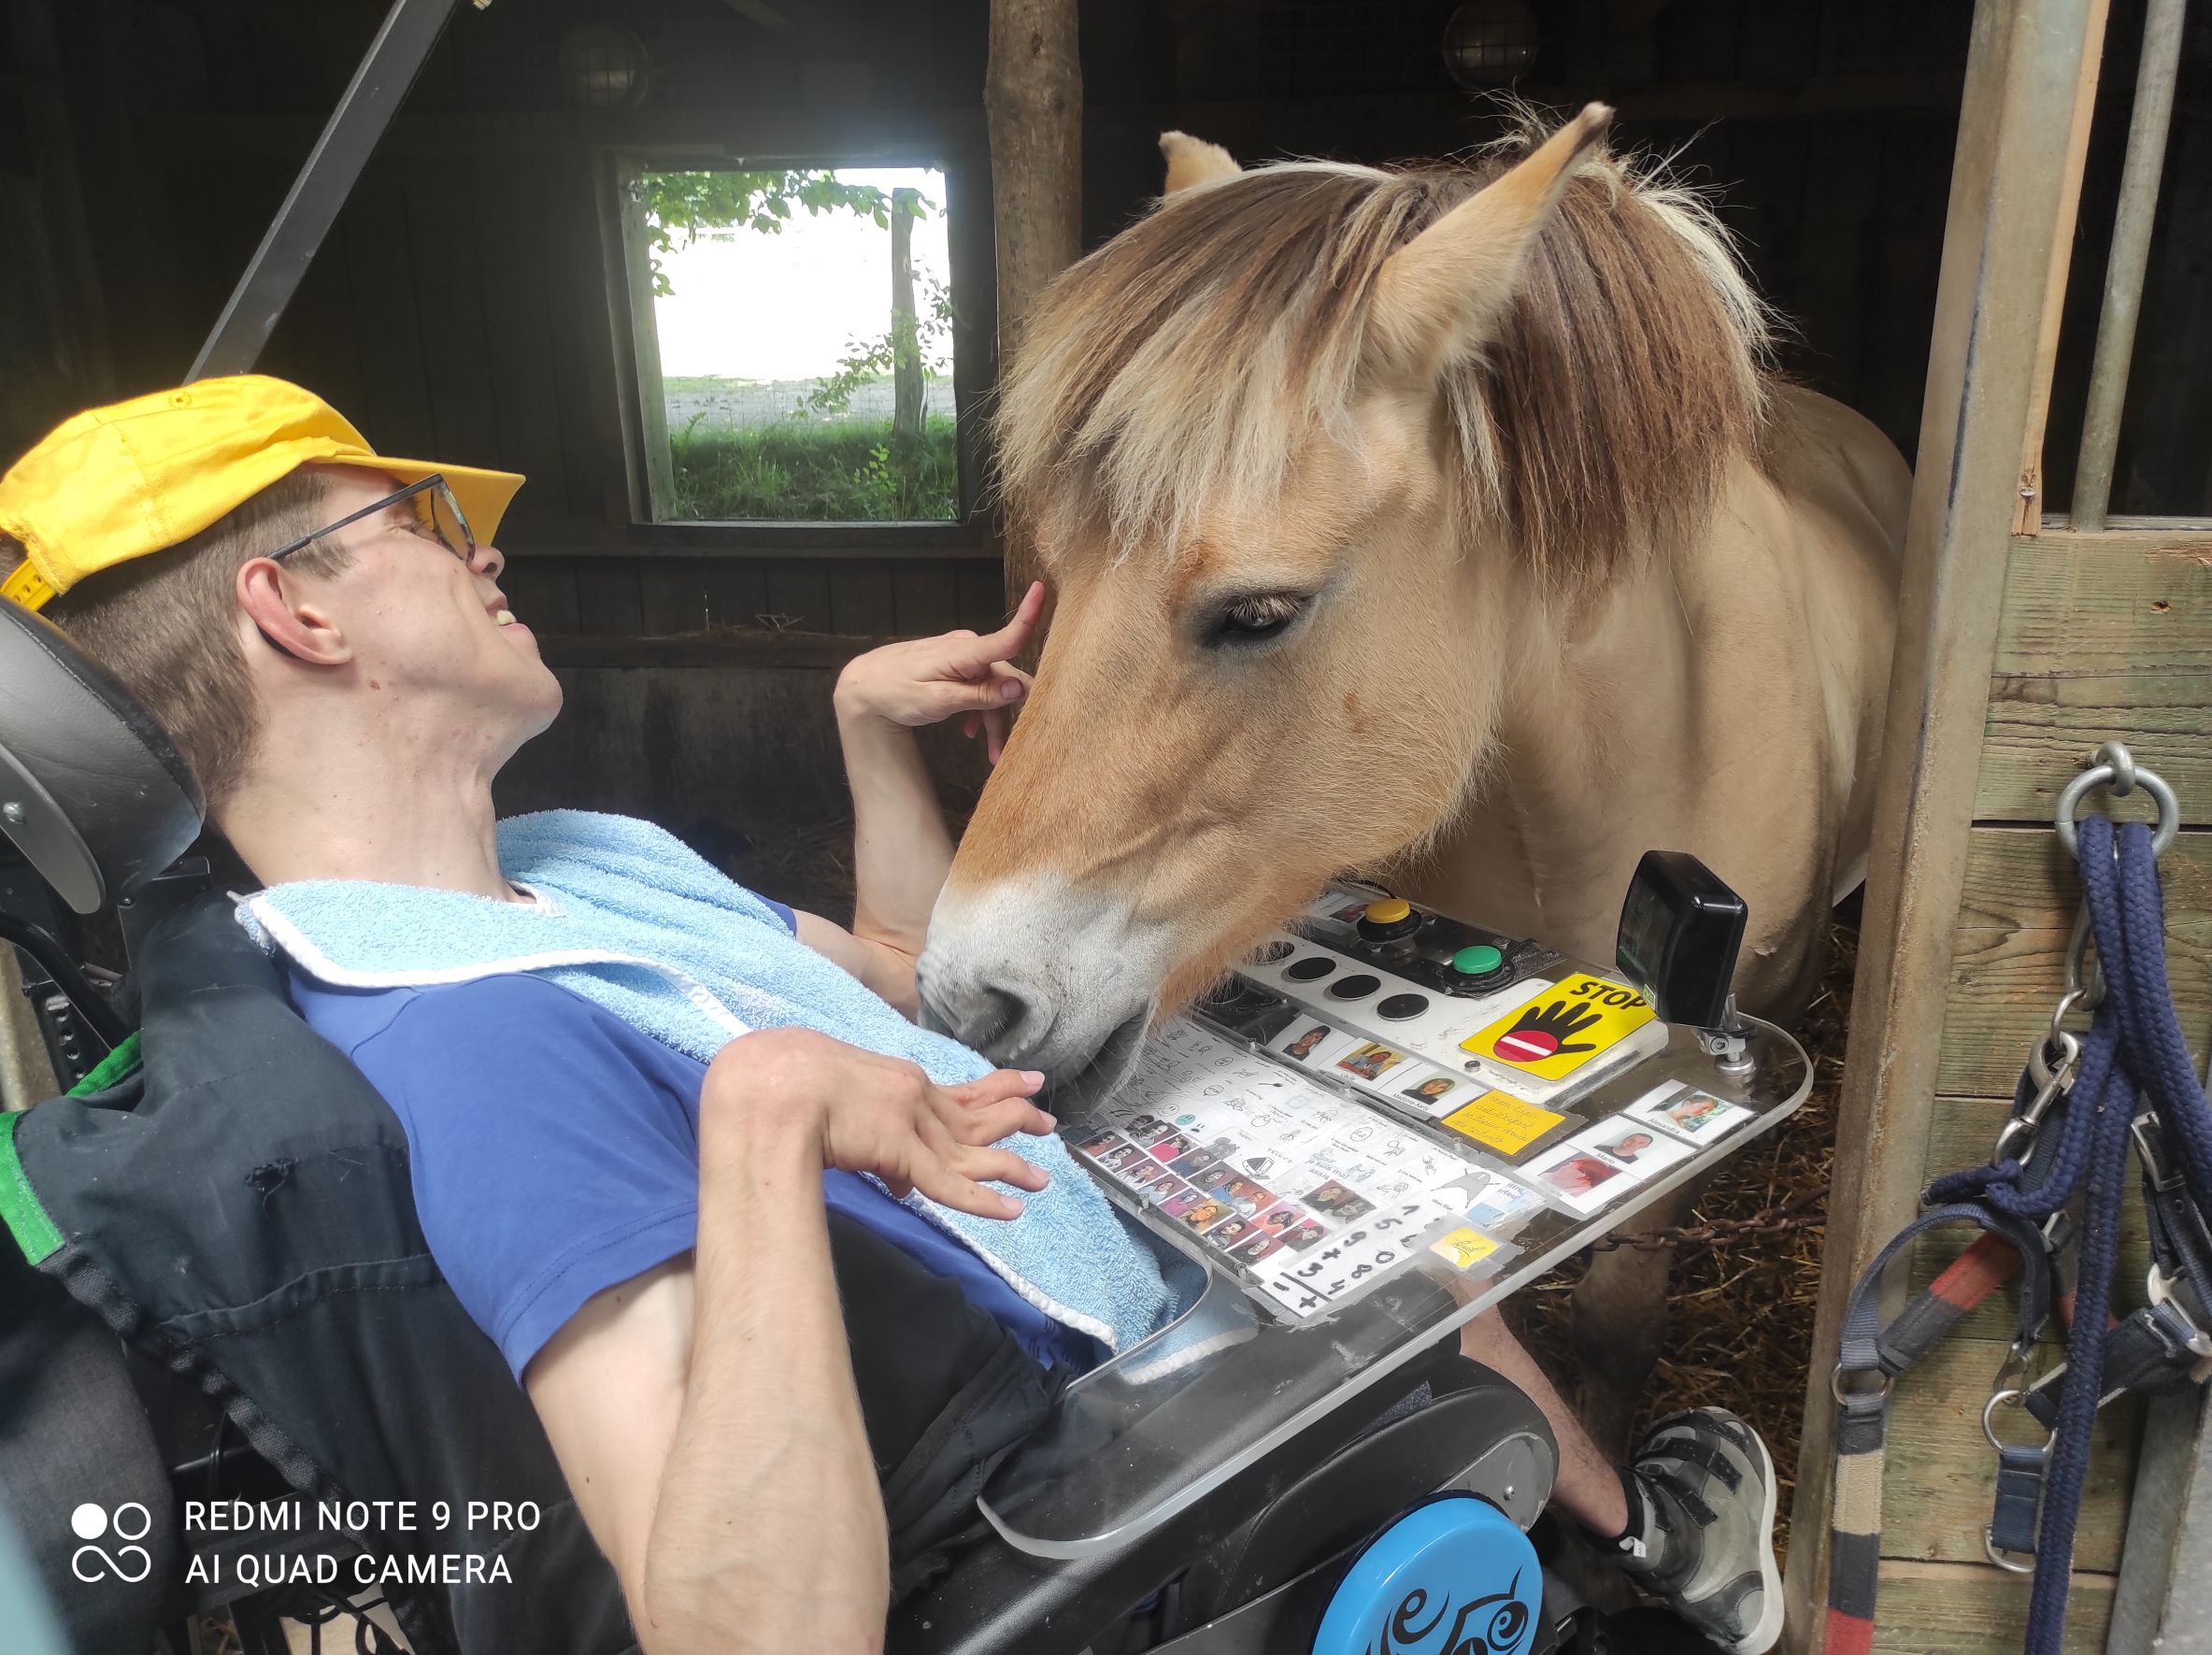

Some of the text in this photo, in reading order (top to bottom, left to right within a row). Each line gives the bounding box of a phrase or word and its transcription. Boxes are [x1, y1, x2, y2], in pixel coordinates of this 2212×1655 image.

[1570, 981, 1648, 1009] STOP
[1650, 1119, 1681, 1134] Alexandra
[1316, 1160, 1334, 1171] suis
[1308, 1169, 1331, 1180] assis
[1375, 1218, 1403, 1231] 5
[1344, 1231, 1396, 1264] 9 0
[1297, 1262, 1346, 1295] 3 4
[1351, 1263, 1374, 1279] 8
